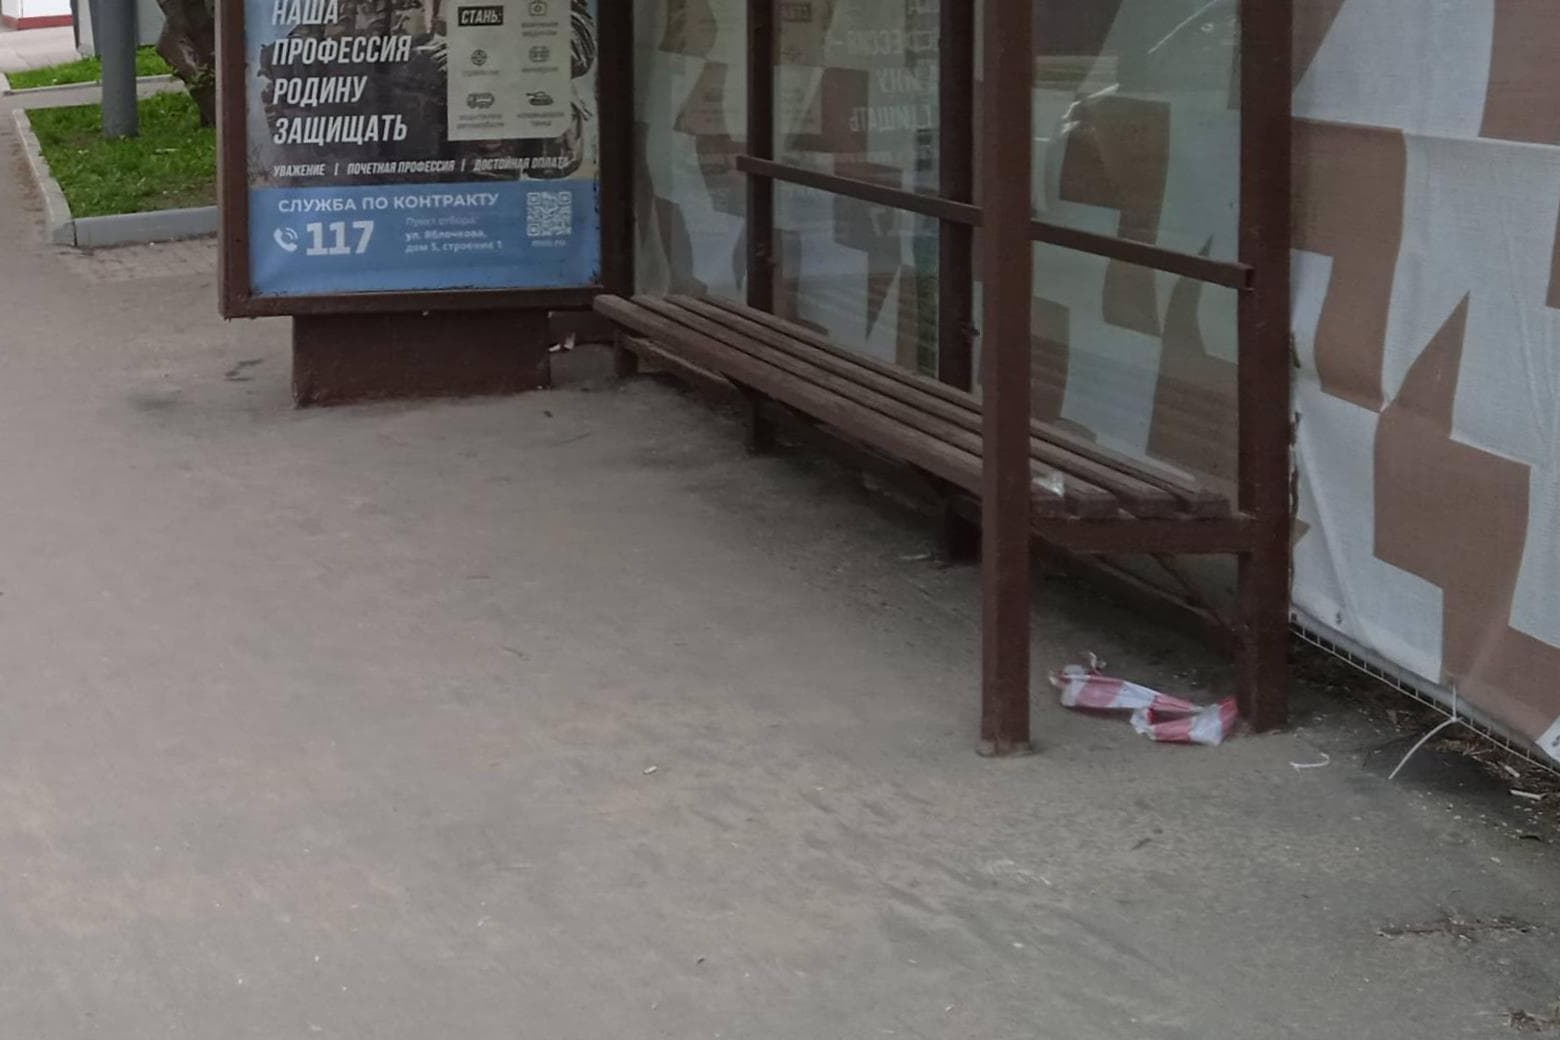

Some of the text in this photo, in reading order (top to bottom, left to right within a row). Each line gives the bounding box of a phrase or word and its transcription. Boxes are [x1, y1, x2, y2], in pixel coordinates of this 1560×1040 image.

[272, 35, 412, 65] ПРОФЕССИЯ
[272, 76, 368, 107] РОДИНУ
[273, 114, 408, 146] ЗАЩИЩАТЬ
[273, 163, 326, 177] УВАЖЕНИЕ
[347, 161, 397, 175] ПОЧЕТНАЯ
[397, 160, 456, 173] ПРОФЕССИЯ
[473, 157, 530, 171] ДОСТОЙНАЯ
[278, 193, 499, 212] СЛУЖБА ПО КОНТРАКТУ
[306, 220, 374, 256] 117
